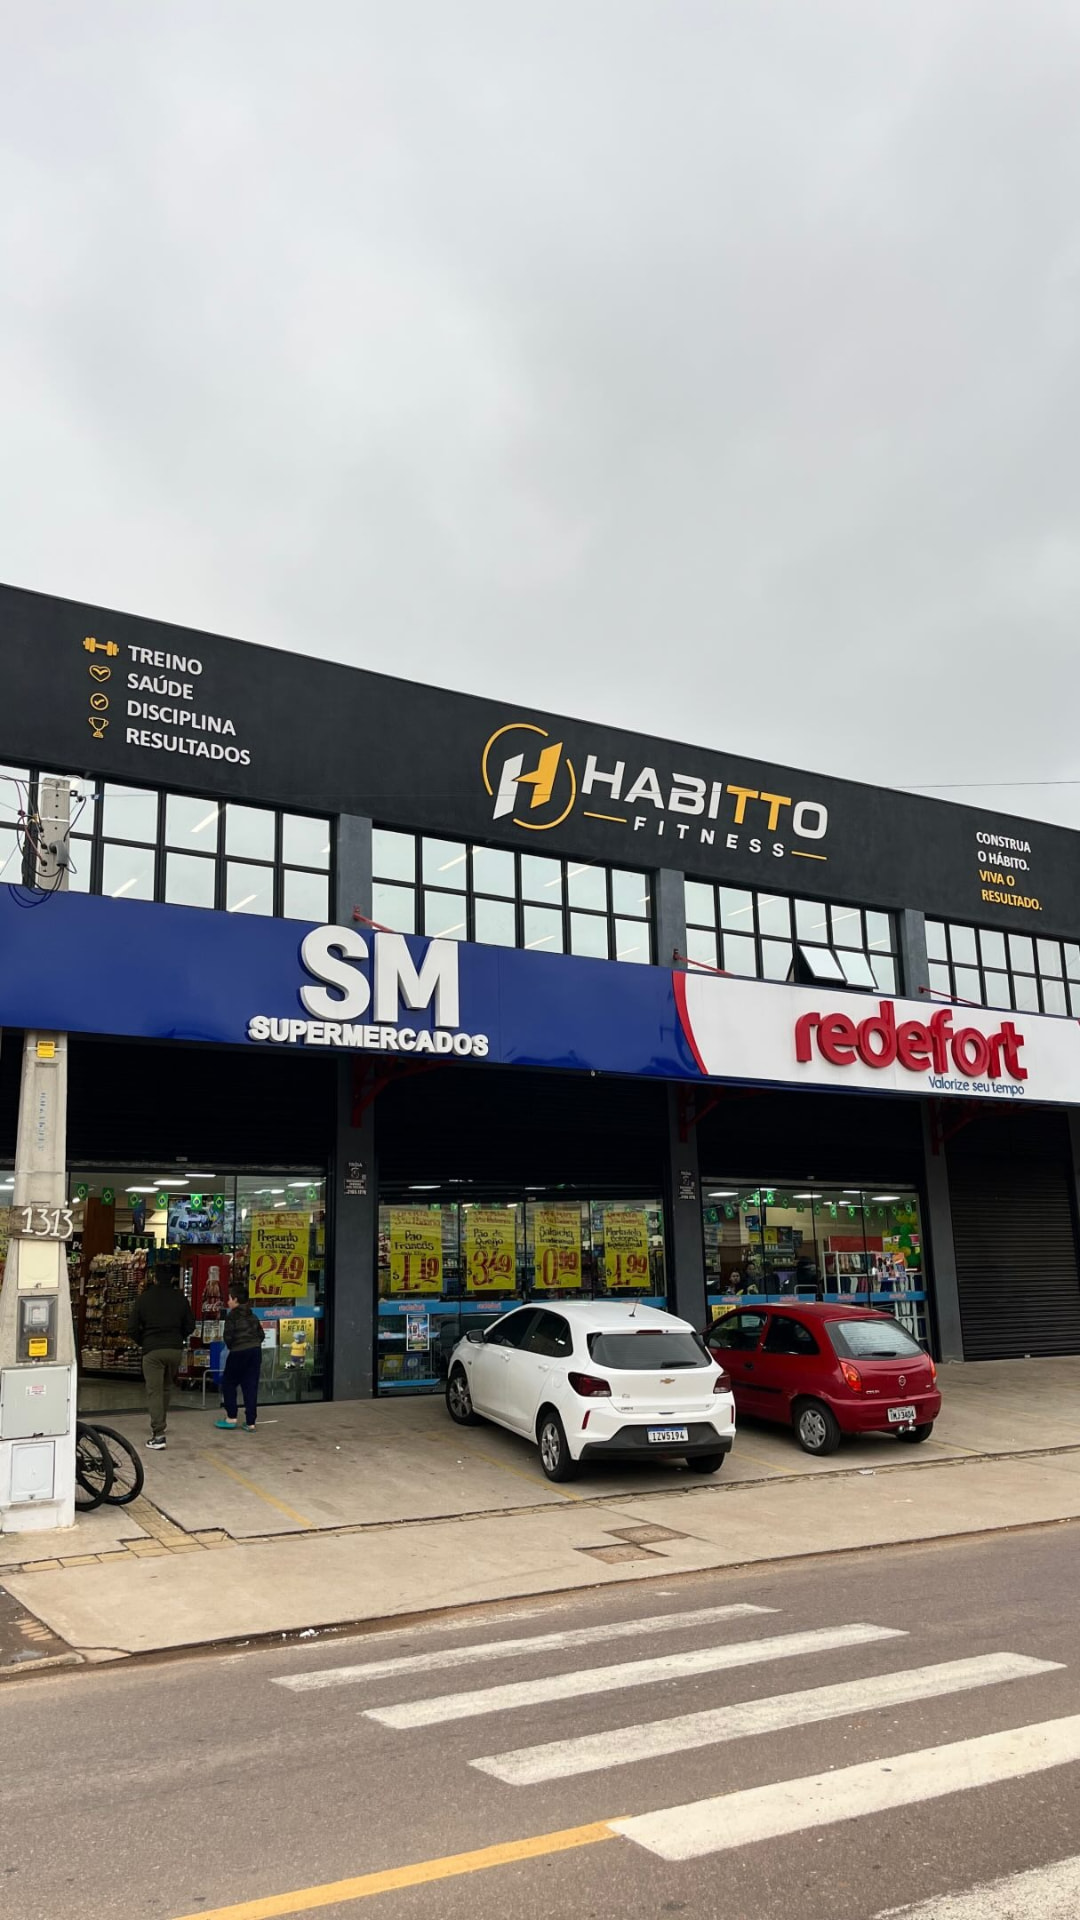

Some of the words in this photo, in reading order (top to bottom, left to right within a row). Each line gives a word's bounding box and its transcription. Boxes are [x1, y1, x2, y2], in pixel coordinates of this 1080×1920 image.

[128, 645, 203, 676] TREINO
[127, 673, 194, 700] SAÚDE
[127, 700, 237, 737] DISCIPLINA
[126, 727, 251, 766] RESULTADOS
[581, 754, 829, 840] HABITTO
[633, 816, 785, 858] FITNESS
[976, 832, 1031, 853] CONSTRUA
[978, 852, 986, 863] O
[989, 852, 1030, 871] HÁBITO.
[979, 870, 1005, 885] VIVA
[1006, 875, 1015, 887] O
[981, 889, 1043, 911] RESULTADO.
[300, 925, 460, 1029] SM
[248, 1015, 489, 1058] SUPERMERCADOS
[795, 1000, 1028, 1081] redefort
[928, 1076, 969, 1092] Valorize
[972, 1082, 990, 1093] seu
[991, 1081, 1025, 1097] tempo
[22, 1207, 73, 1239] 1313
